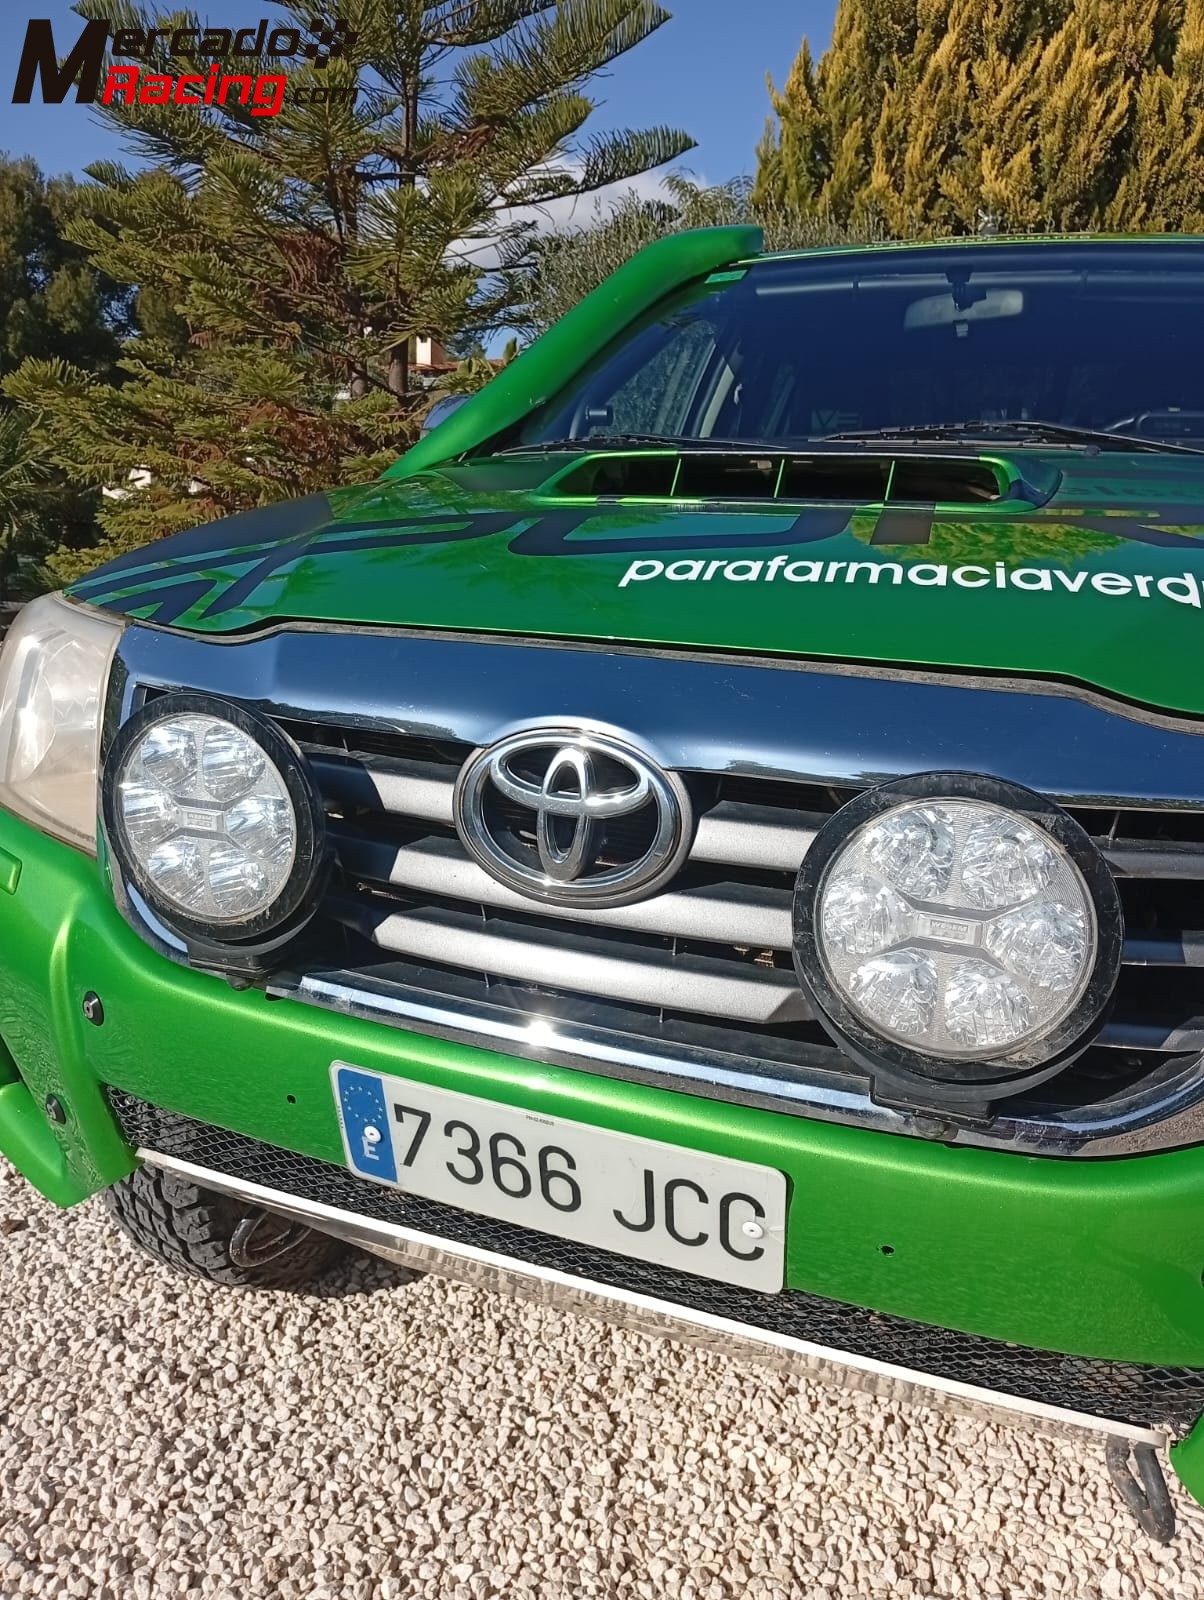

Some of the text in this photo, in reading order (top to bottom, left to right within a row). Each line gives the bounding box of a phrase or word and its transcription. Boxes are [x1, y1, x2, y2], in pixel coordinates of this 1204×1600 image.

[618, 555, 1204, 609] parafarmaciaverd
[362, 1103, 766, 1261] E 7366 JCC
